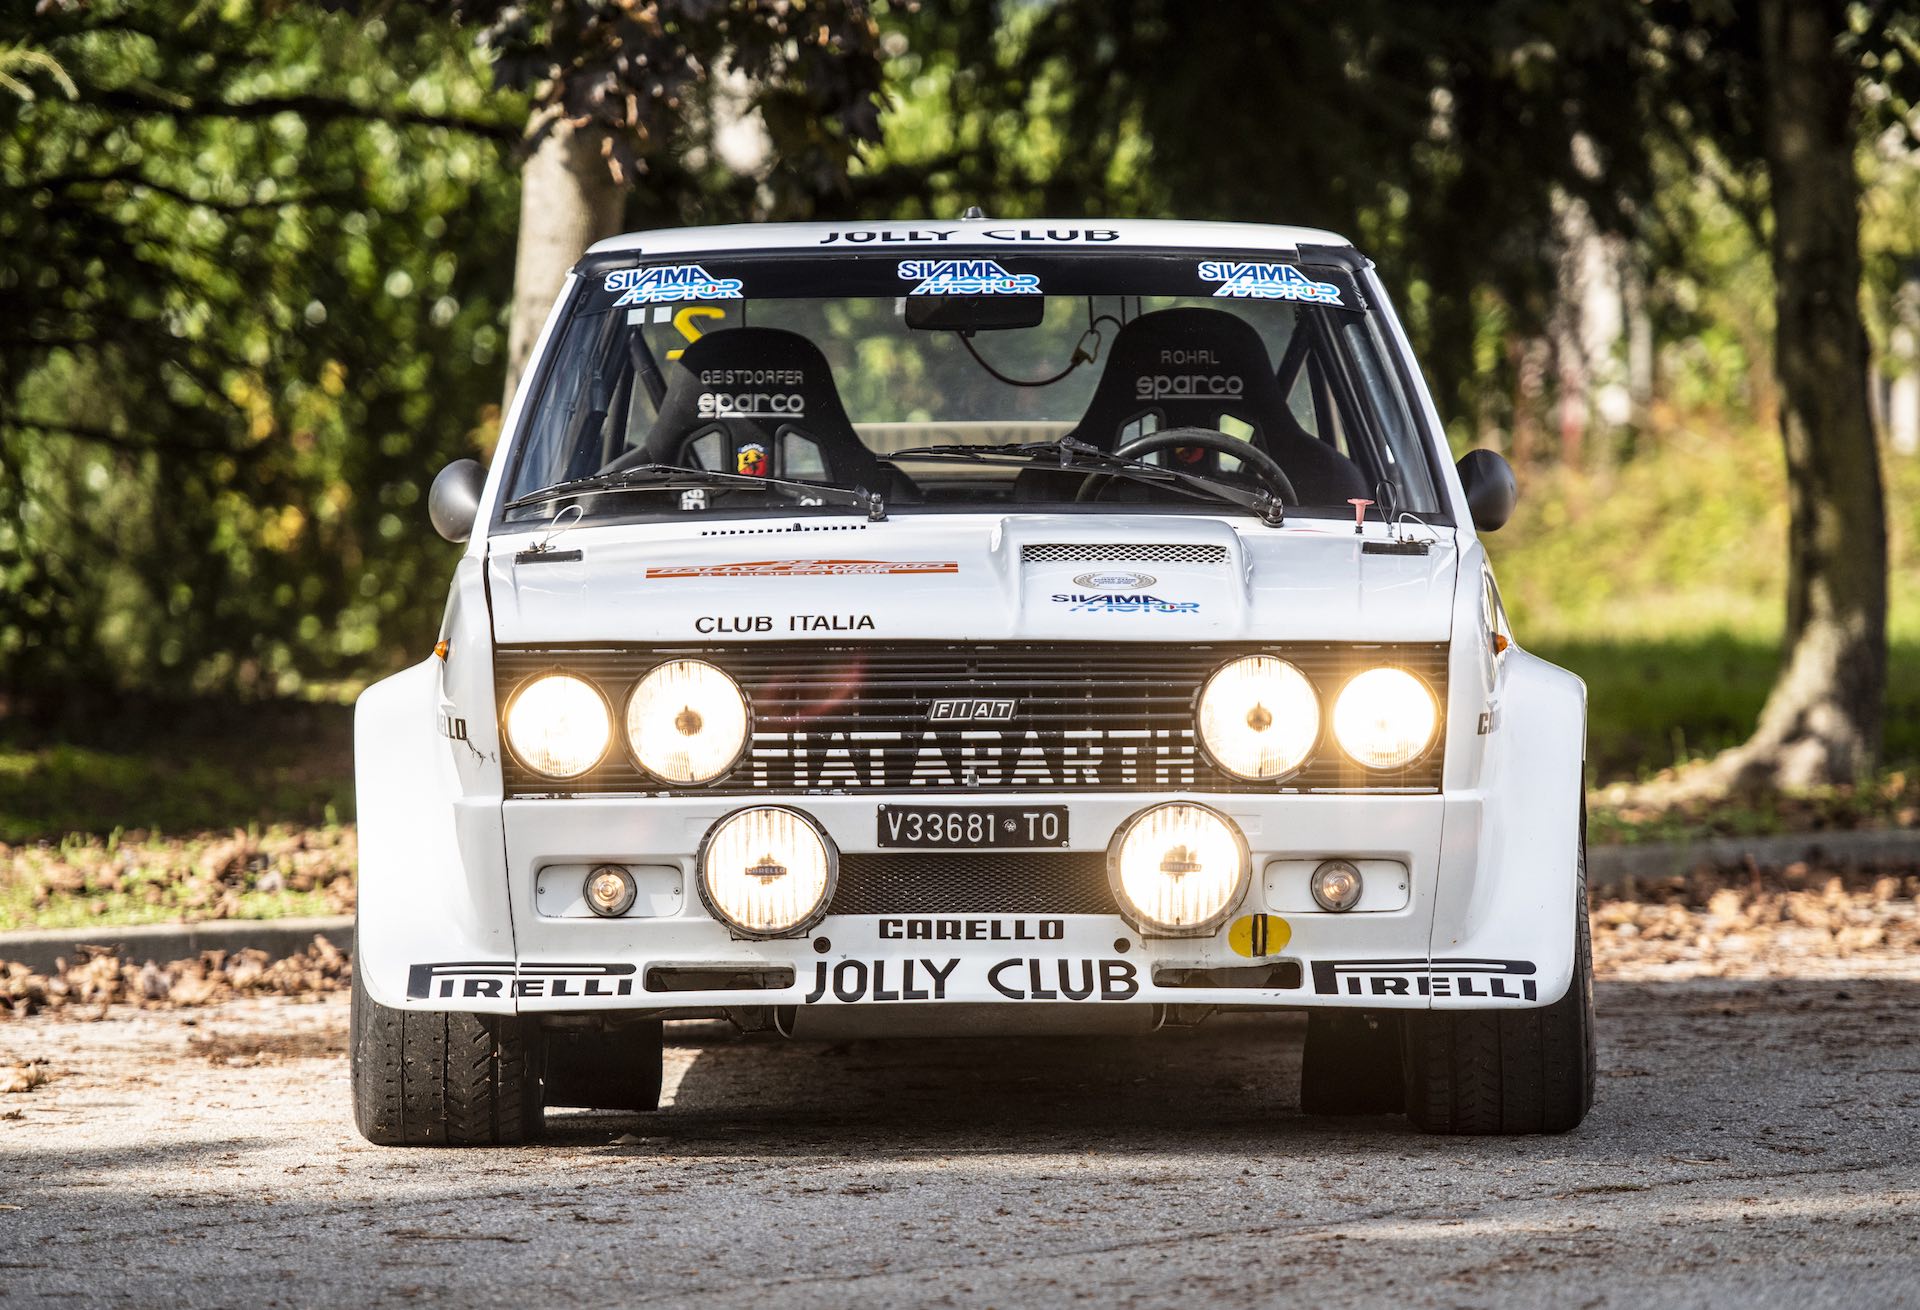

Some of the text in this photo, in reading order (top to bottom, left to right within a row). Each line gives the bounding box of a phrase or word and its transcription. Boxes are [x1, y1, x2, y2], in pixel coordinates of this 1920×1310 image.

[819, 229, 1121, 244] JOLLY CLUB
[606, 266, 712, 290] SIVAMA
[900, 261, 1006, 280] SIVAMA
[1201, 262, 1304, 283] SIVAMA
[617, 280, 742, 305] MOTOR
[913, 275, 1041, 294] MOTOR
[1216, 277, 1342, 305] MOTOR
[1160, 349, 1220, 364] ROHRL
[700, 369, 805, 385] GEISTDORFER
[1136, 374, 1244, 400] sparco
[697, 392, 806, 420] sparco
[1051, 593, 1169, 605] SIVAMA
[694, 614, 876, 634] CLUB ITALIA
[935, 702, 1013, 718] FIAT
[886, 812, 1060, 843] V33681 TO
[878, 919, 1065, 941] CARELLO
[405, 960, 637, 1001] PIRELLI
[805, 958, 1140, 1005] JOLLY CLUB
[1310, 957, 1538, 1003] PIRELLI
